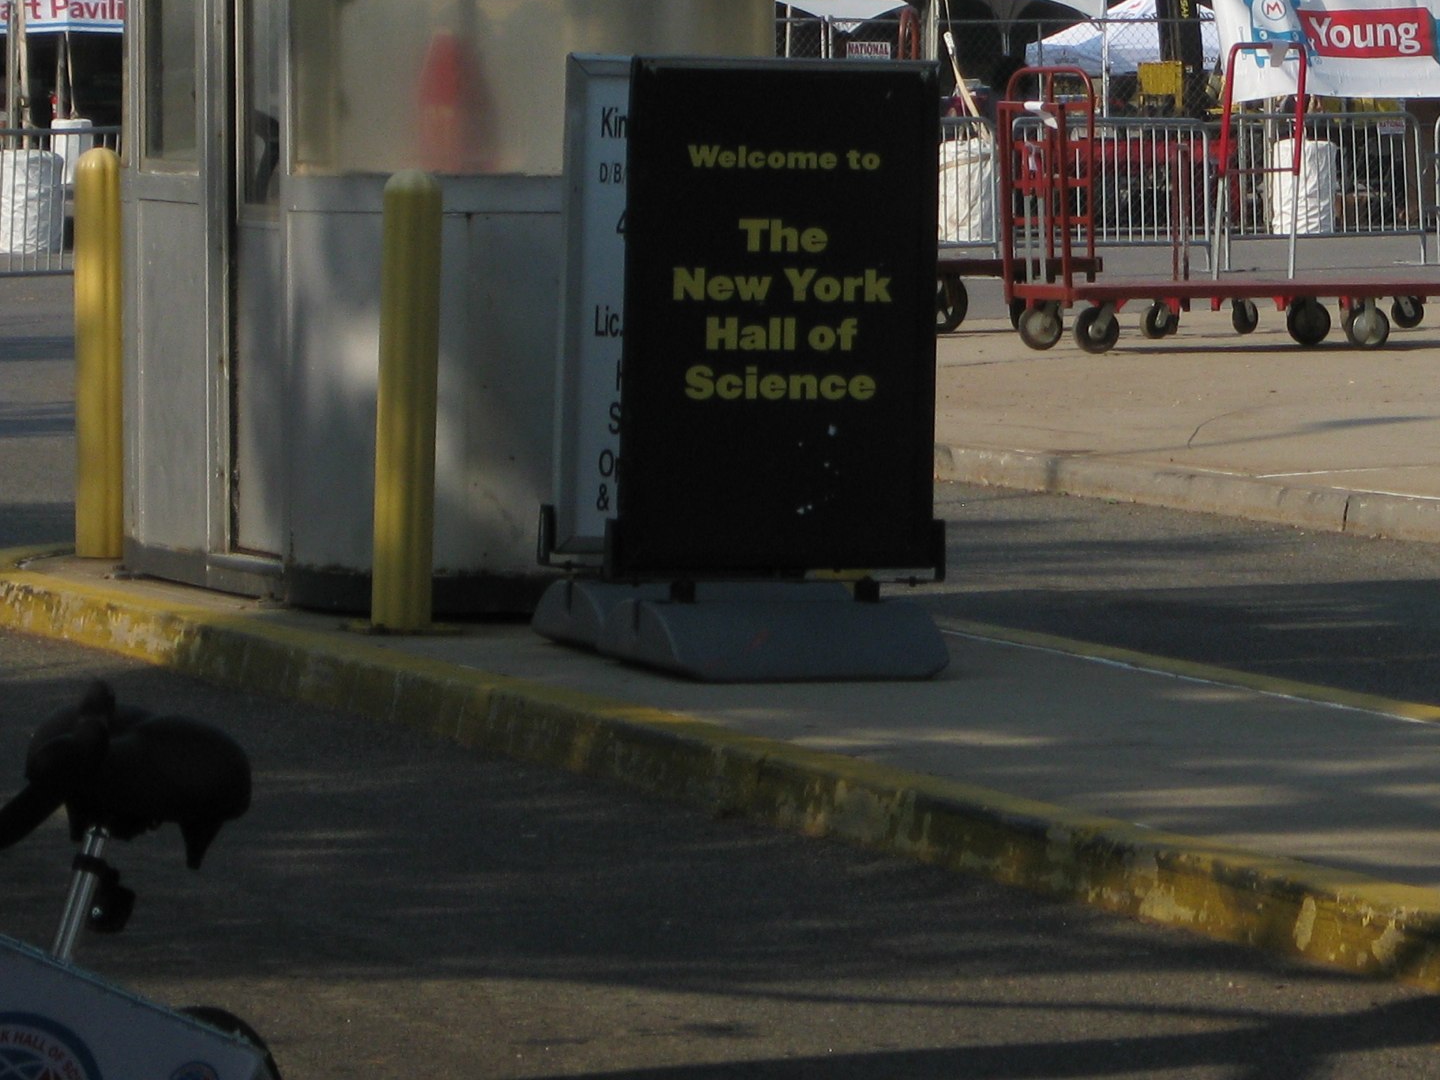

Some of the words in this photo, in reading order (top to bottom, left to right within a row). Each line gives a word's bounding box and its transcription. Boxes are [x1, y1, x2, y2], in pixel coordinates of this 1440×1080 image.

[848, 42, 889, 55] NATIONAL
[1308, 16, 1421, 54] Young
[688, 144, 839, 169] Welcome
[846, 149, 882, 170] to
[738, 218, 829, 253] The
[673, 267, 773, 302] New
[783, 268, 893, 303] York
[705, 317, 797, 351] Hall
[807, 318, 859, 352] of
[684, 365, 877, 401] Science
[596, 483, 610, 512] &
